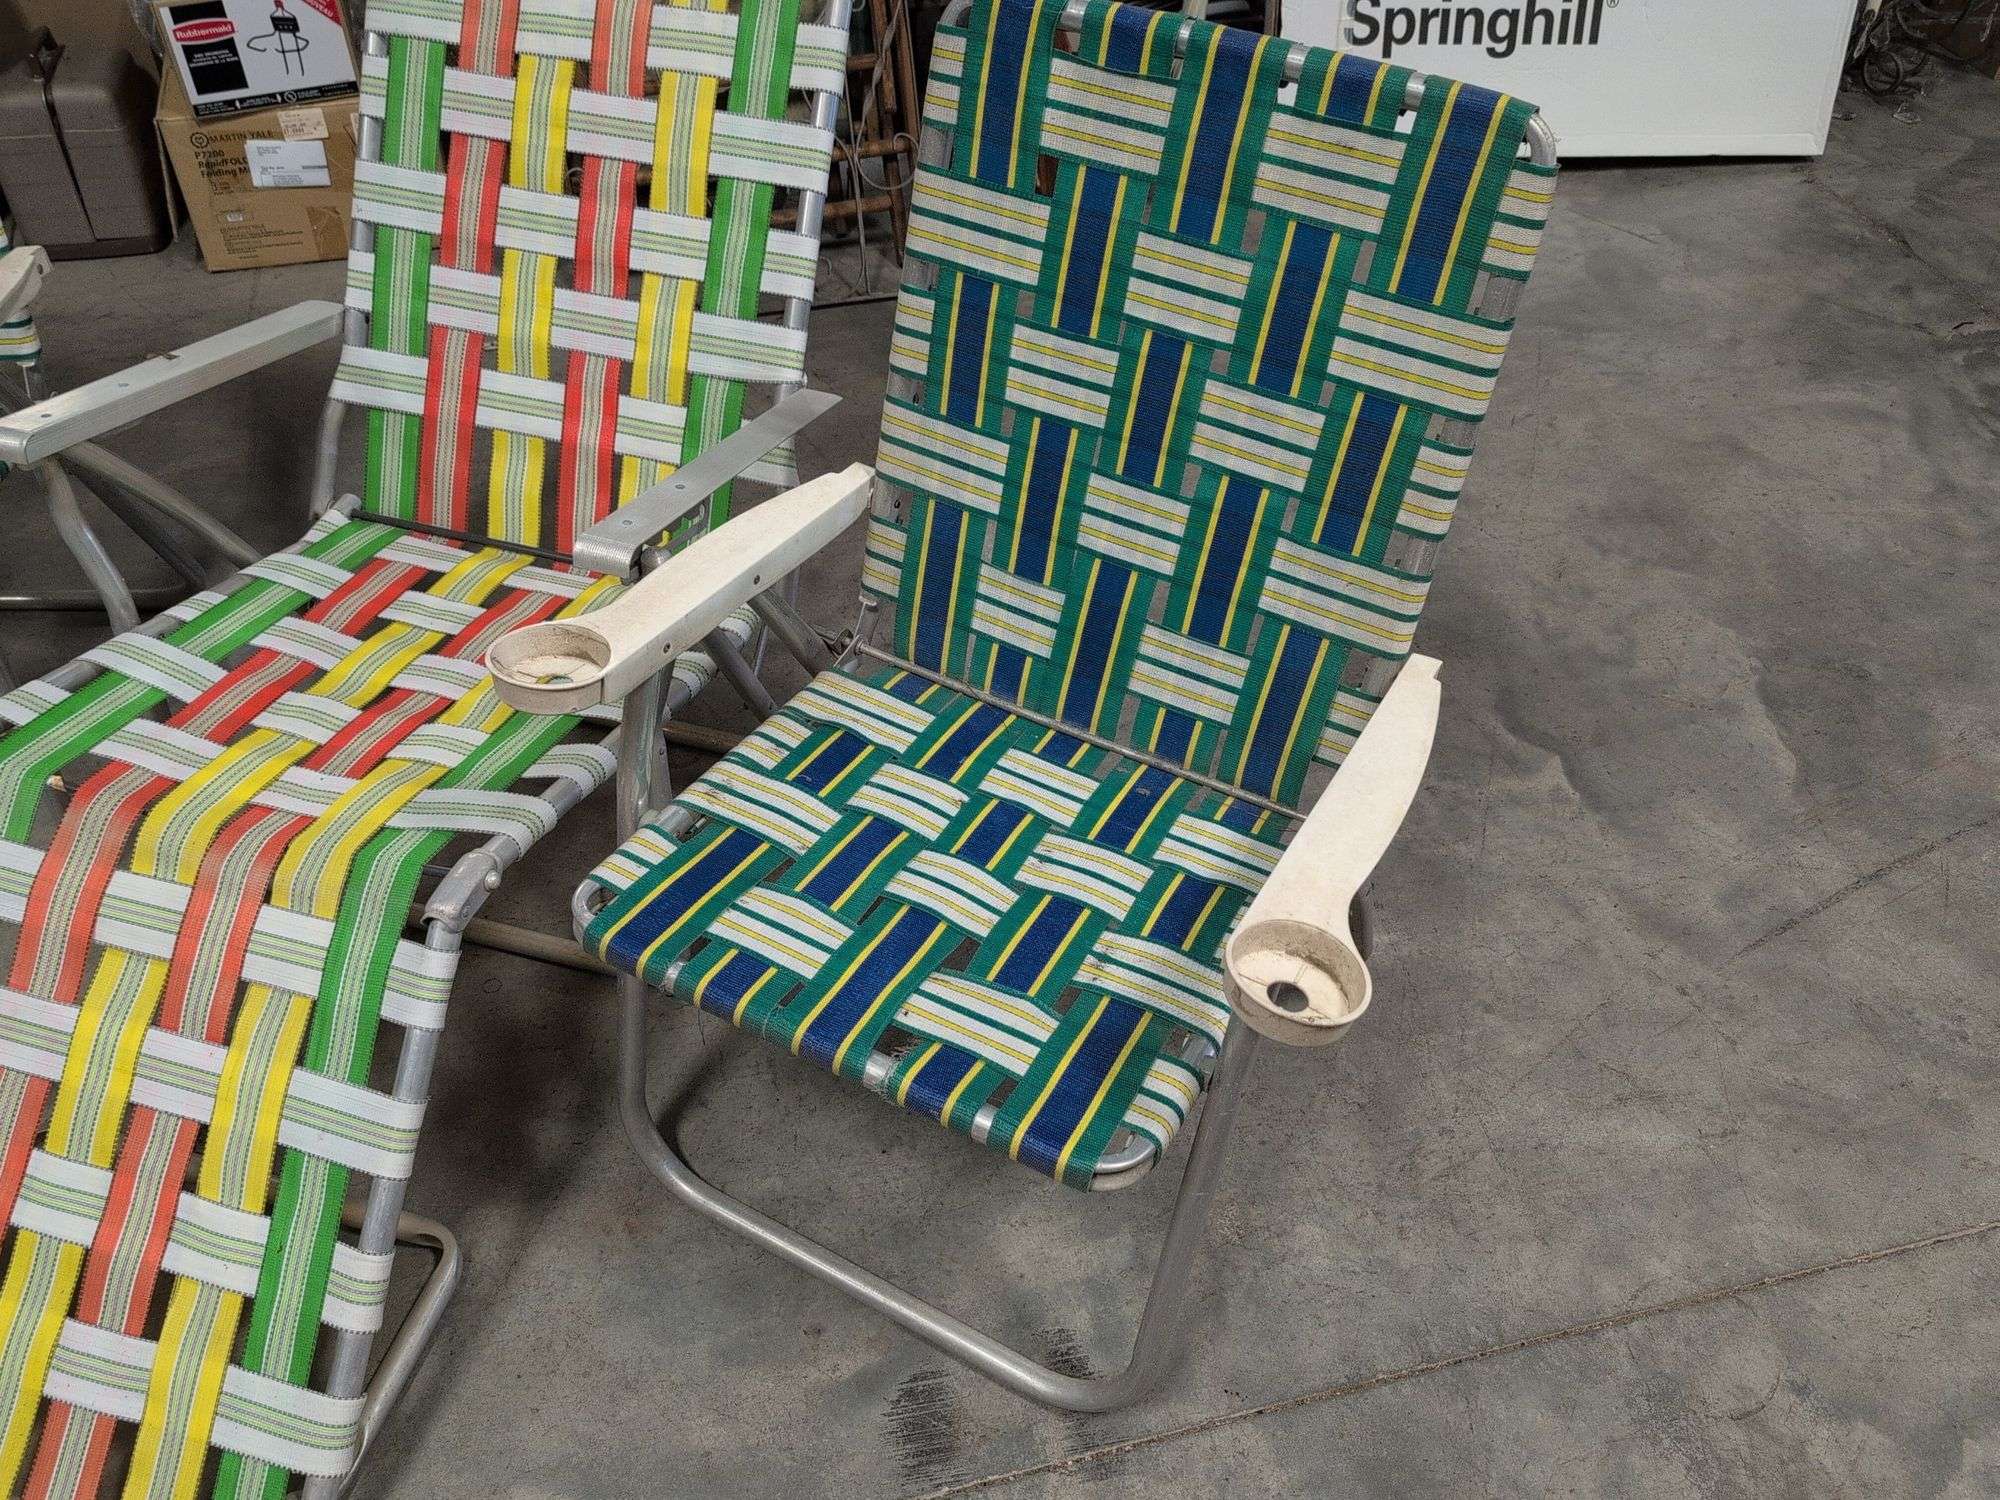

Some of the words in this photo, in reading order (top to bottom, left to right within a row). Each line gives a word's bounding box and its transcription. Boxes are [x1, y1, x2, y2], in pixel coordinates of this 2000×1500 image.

[175, 23, 232, 39] Rubbermaid
[209, 132, 247, 143] MARTIN
[201, 167, 238, 178] Folding
